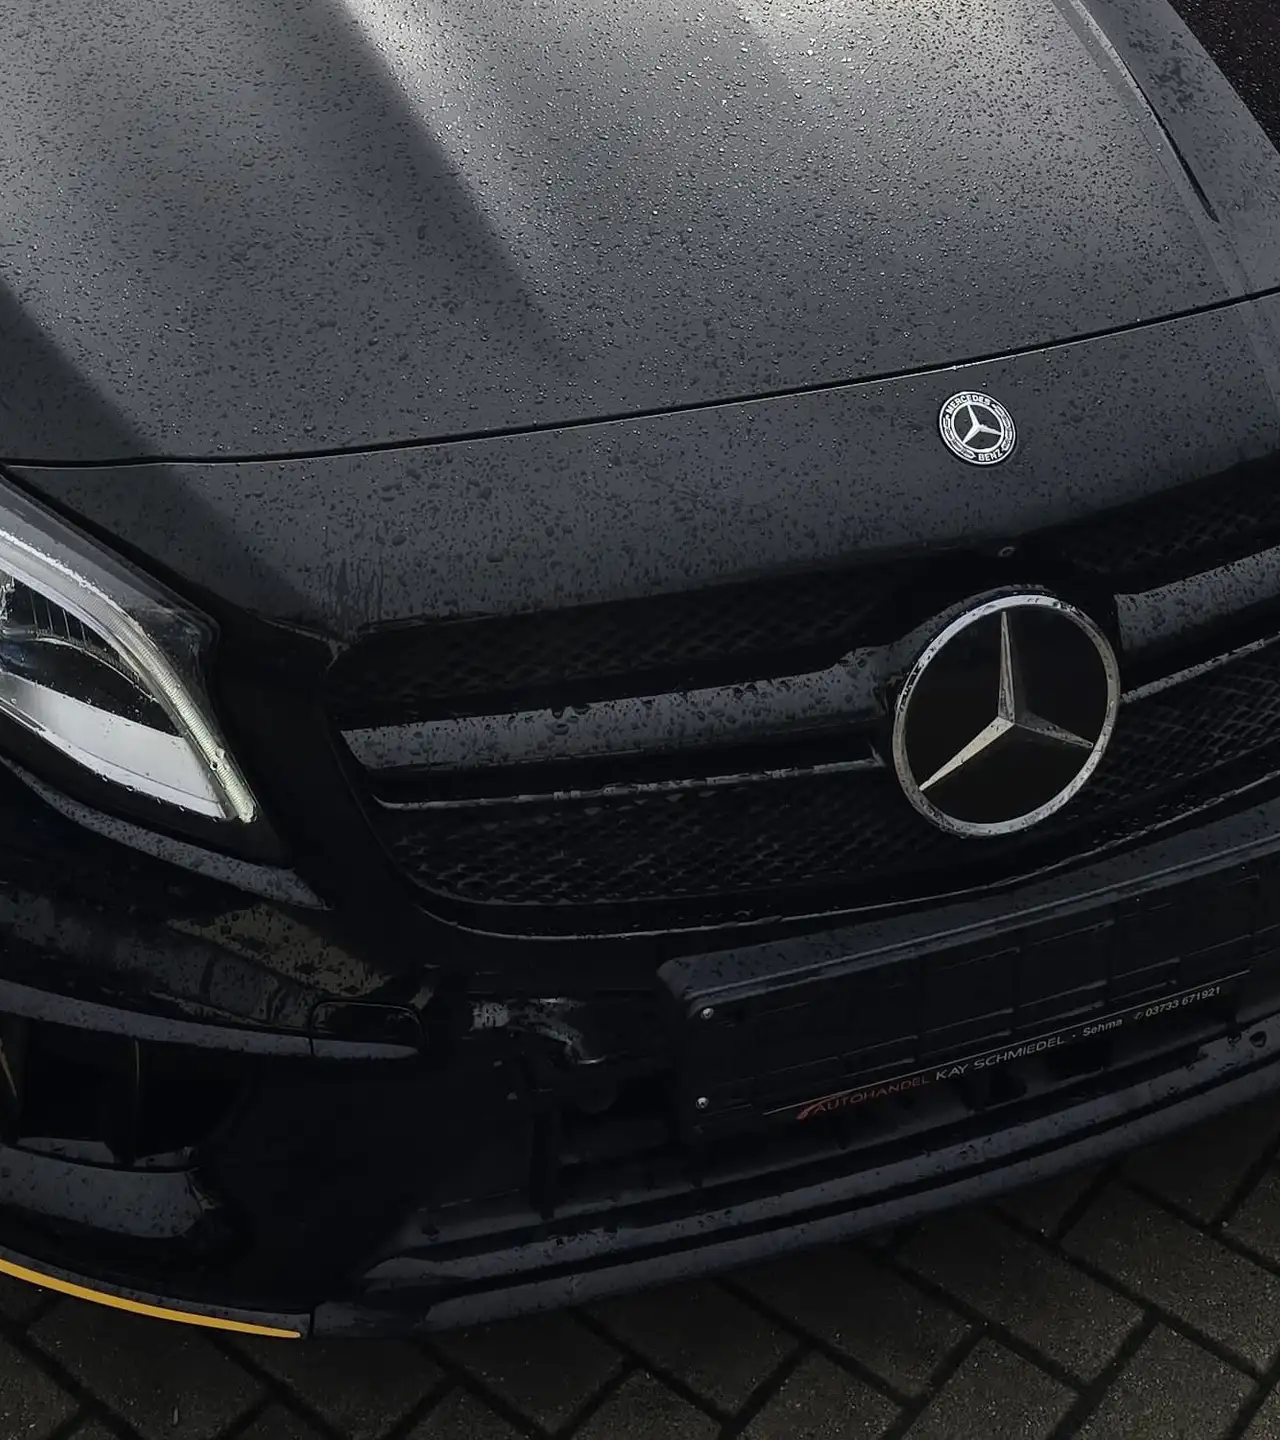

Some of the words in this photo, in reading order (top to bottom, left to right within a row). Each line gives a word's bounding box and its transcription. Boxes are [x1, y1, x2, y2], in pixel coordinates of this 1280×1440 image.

[945, 394, 991, 415] MERCEDES
[977, 449, 1003, 462] BENZ
[810, 1075, 931, 1116] AUTOHANDEL
[935, 1063, 969, 1081] KAY
[972, 1035, 1067, 1071] SCHMIEDEL
[1082, 1018, 1124, 1037] Sehma
[1145, 1000, 1180, 1018] 03733
[1181, 986, 1221, 1006] 671921
